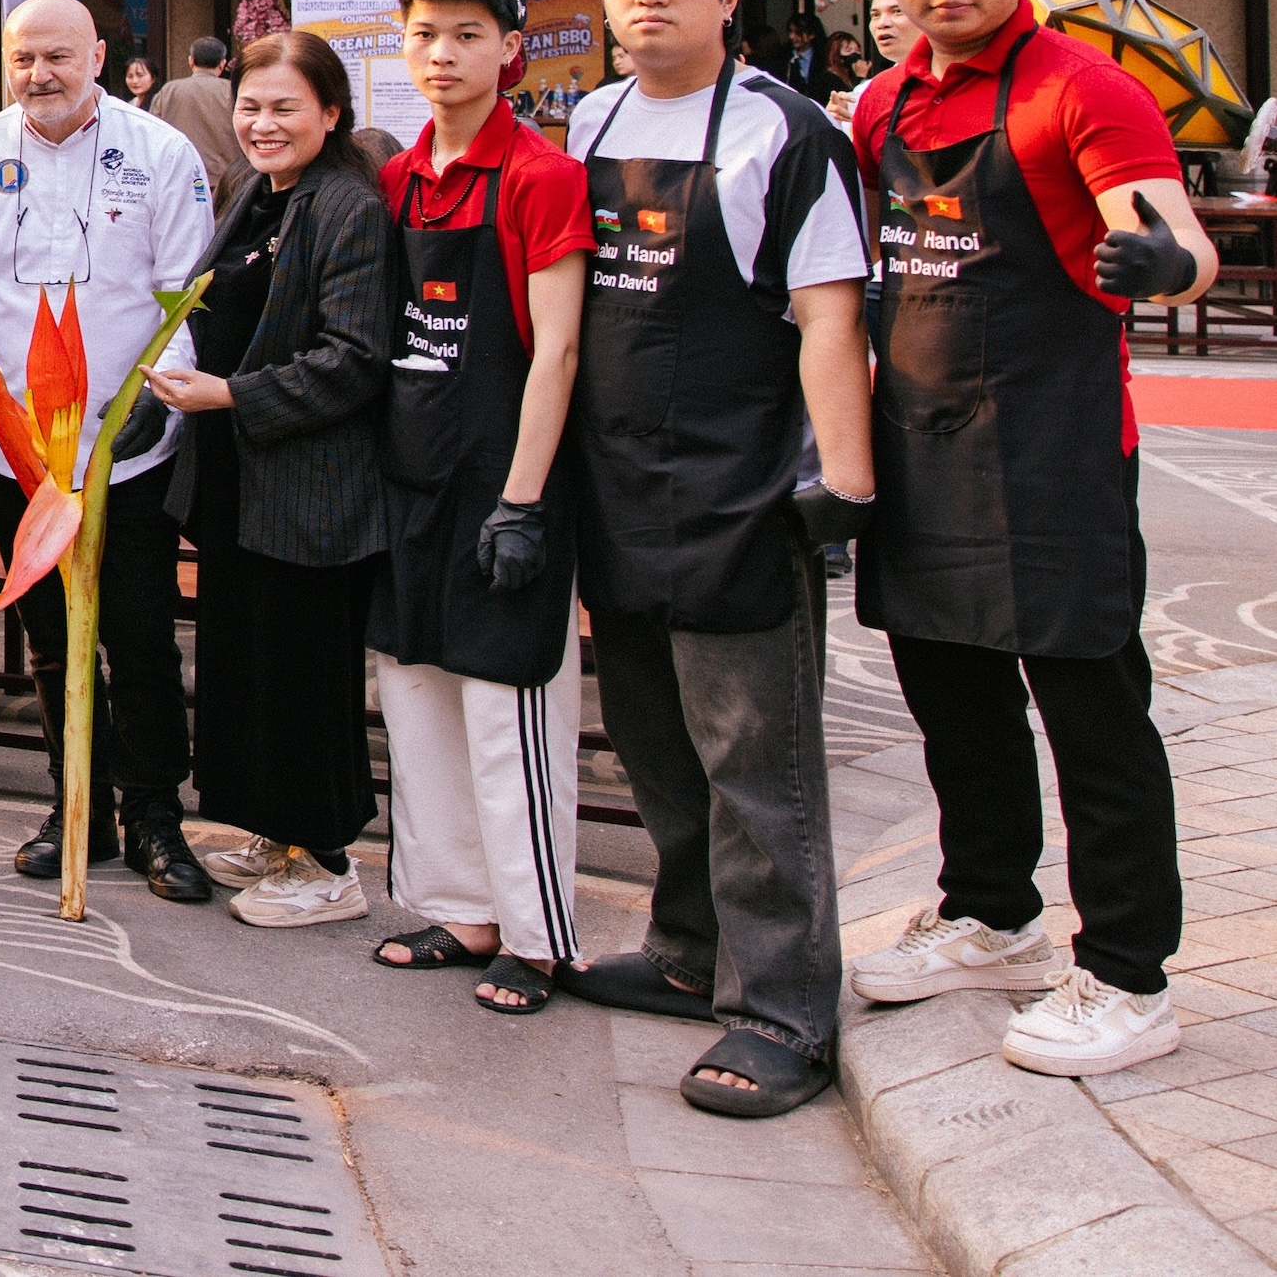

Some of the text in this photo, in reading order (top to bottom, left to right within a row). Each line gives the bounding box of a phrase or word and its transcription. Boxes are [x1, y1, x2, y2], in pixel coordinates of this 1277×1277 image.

[329, 33, 403, 51] OCEAN BBQ
[523, 29, 592, 50] EAN BBQ
[541, 45, 587, 58] FESTIVAL
[880, 225, 980, 251] Baku Hanoi
[627, 244, 675, 266] Hanoi
[888, 257, 960, 278] Don David
[594, 271, 657, 293] Don David
[407, 331, 428, 351] Don
